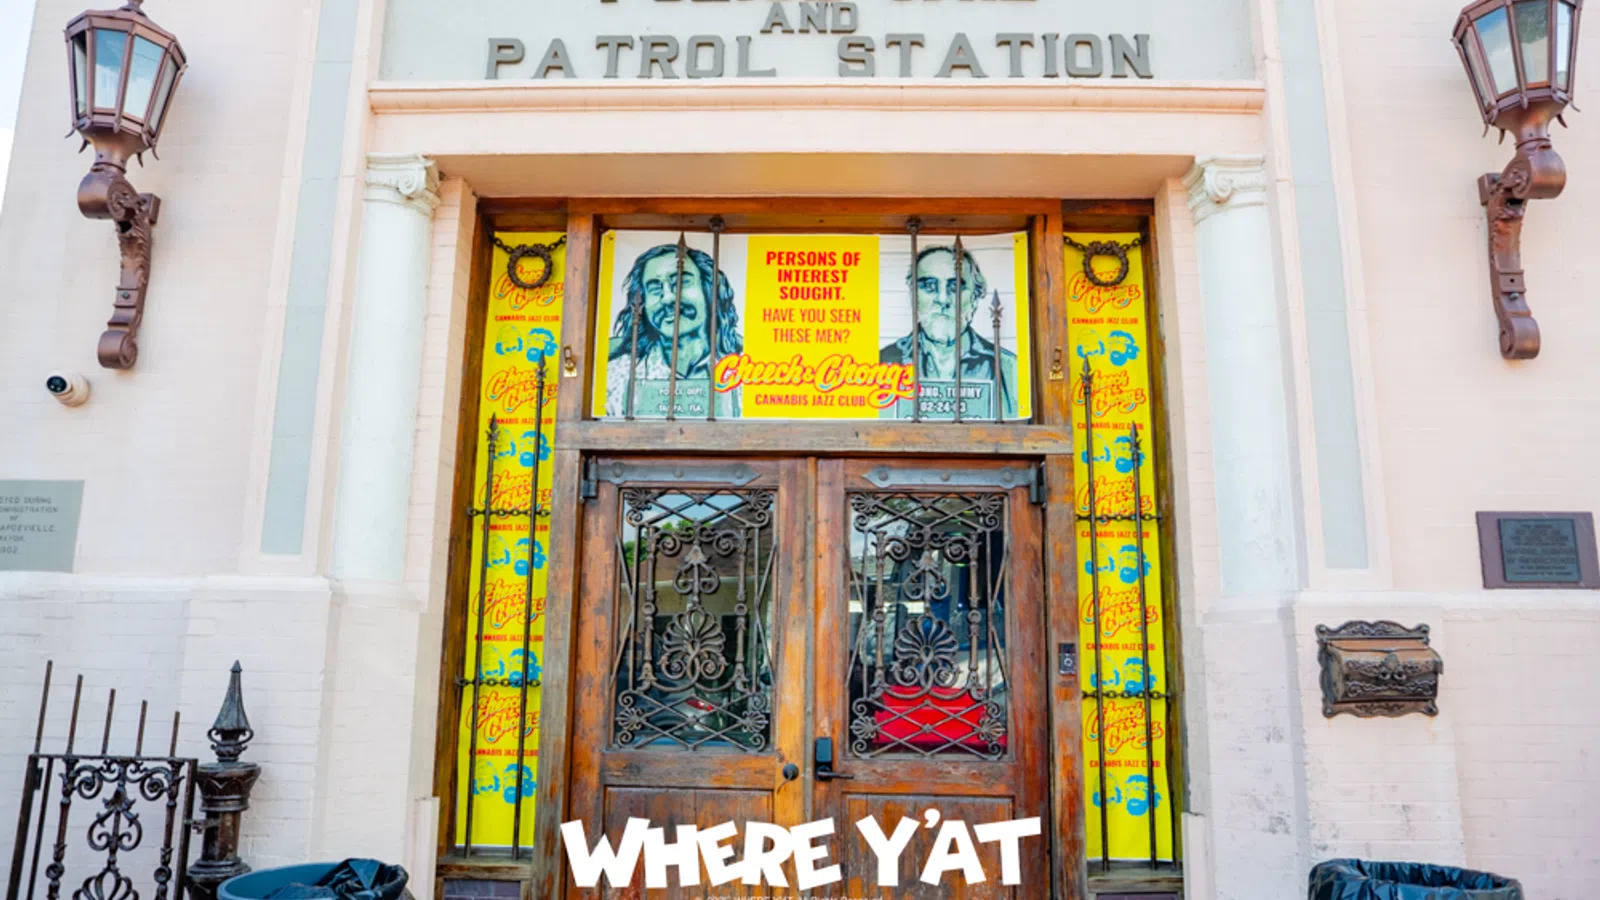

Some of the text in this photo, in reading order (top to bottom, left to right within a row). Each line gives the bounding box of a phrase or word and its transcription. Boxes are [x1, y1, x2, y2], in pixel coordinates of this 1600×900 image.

[760, 1, 858, 33] AND
[484, 32, 1153, 79] PATROL STATION
[766, 251, 861, 266] PERSONS OF
[777, 269, 848, 283] INTEREST
[779, 286, 846, 300] SOUGHT.
[762, 308, 861, 323] HAVE YOU SEEN
[773, 328, 851, 343] THESE MEN?
[755, 394, 866, 407] CANNABIS JAZZ CLUB
[920, 401, 967, 413] 02-24-3
[468, 748, 502, 756] NNABIS
[1089, 760, 1122, 768] CANABIS
[1141, 760, 1160, 768] CUB
